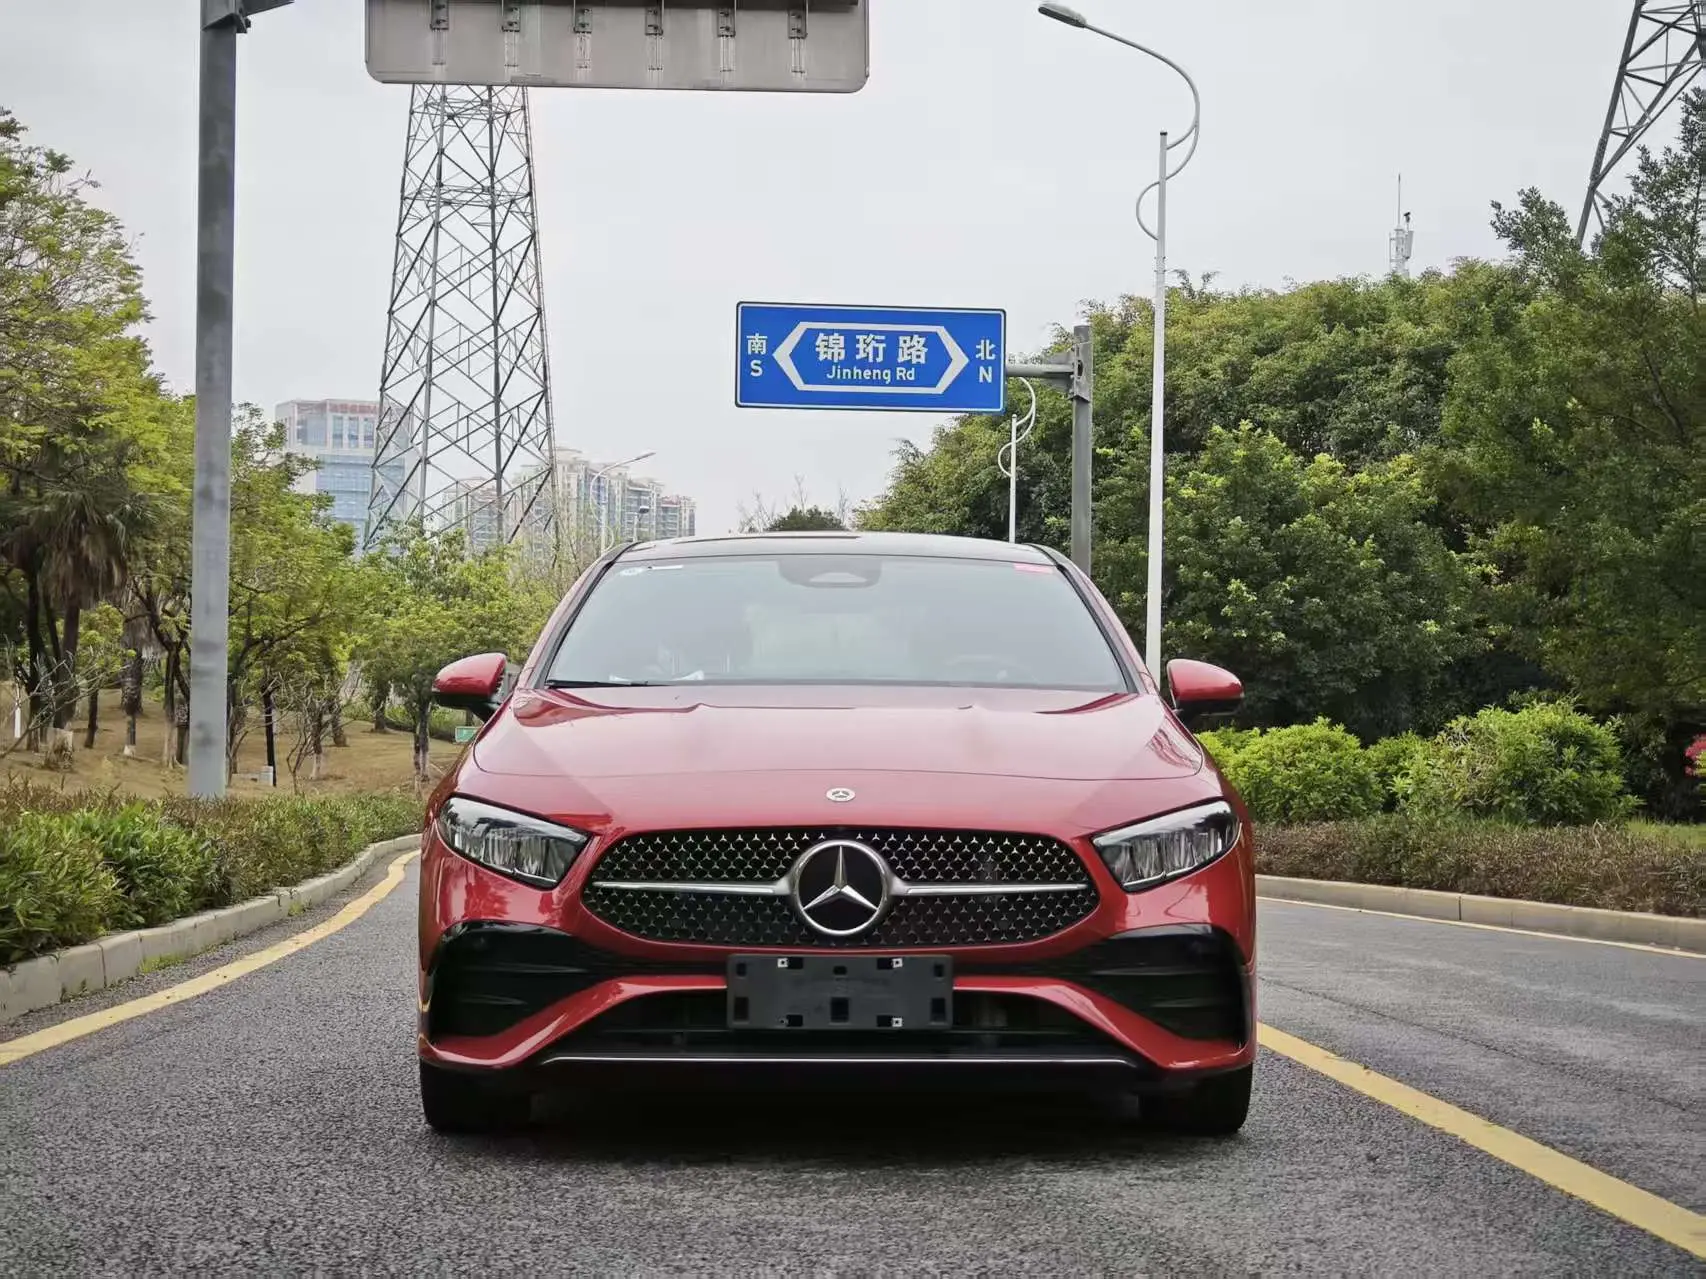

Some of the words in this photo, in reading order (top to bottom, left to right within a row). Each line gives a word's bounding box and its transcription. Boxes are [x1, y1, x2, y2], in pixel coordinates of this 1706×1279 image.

[747, 333, 767, 355] 南
[815, 332, 928, 365] 锦珩路
[976, 339, 996, 361] 北
[750, 360, 763, 377] S
[826, 365, 891, 384] Jinheng
[896, 366, 915, 381] Rd
[979, 366, 993, 383] N
